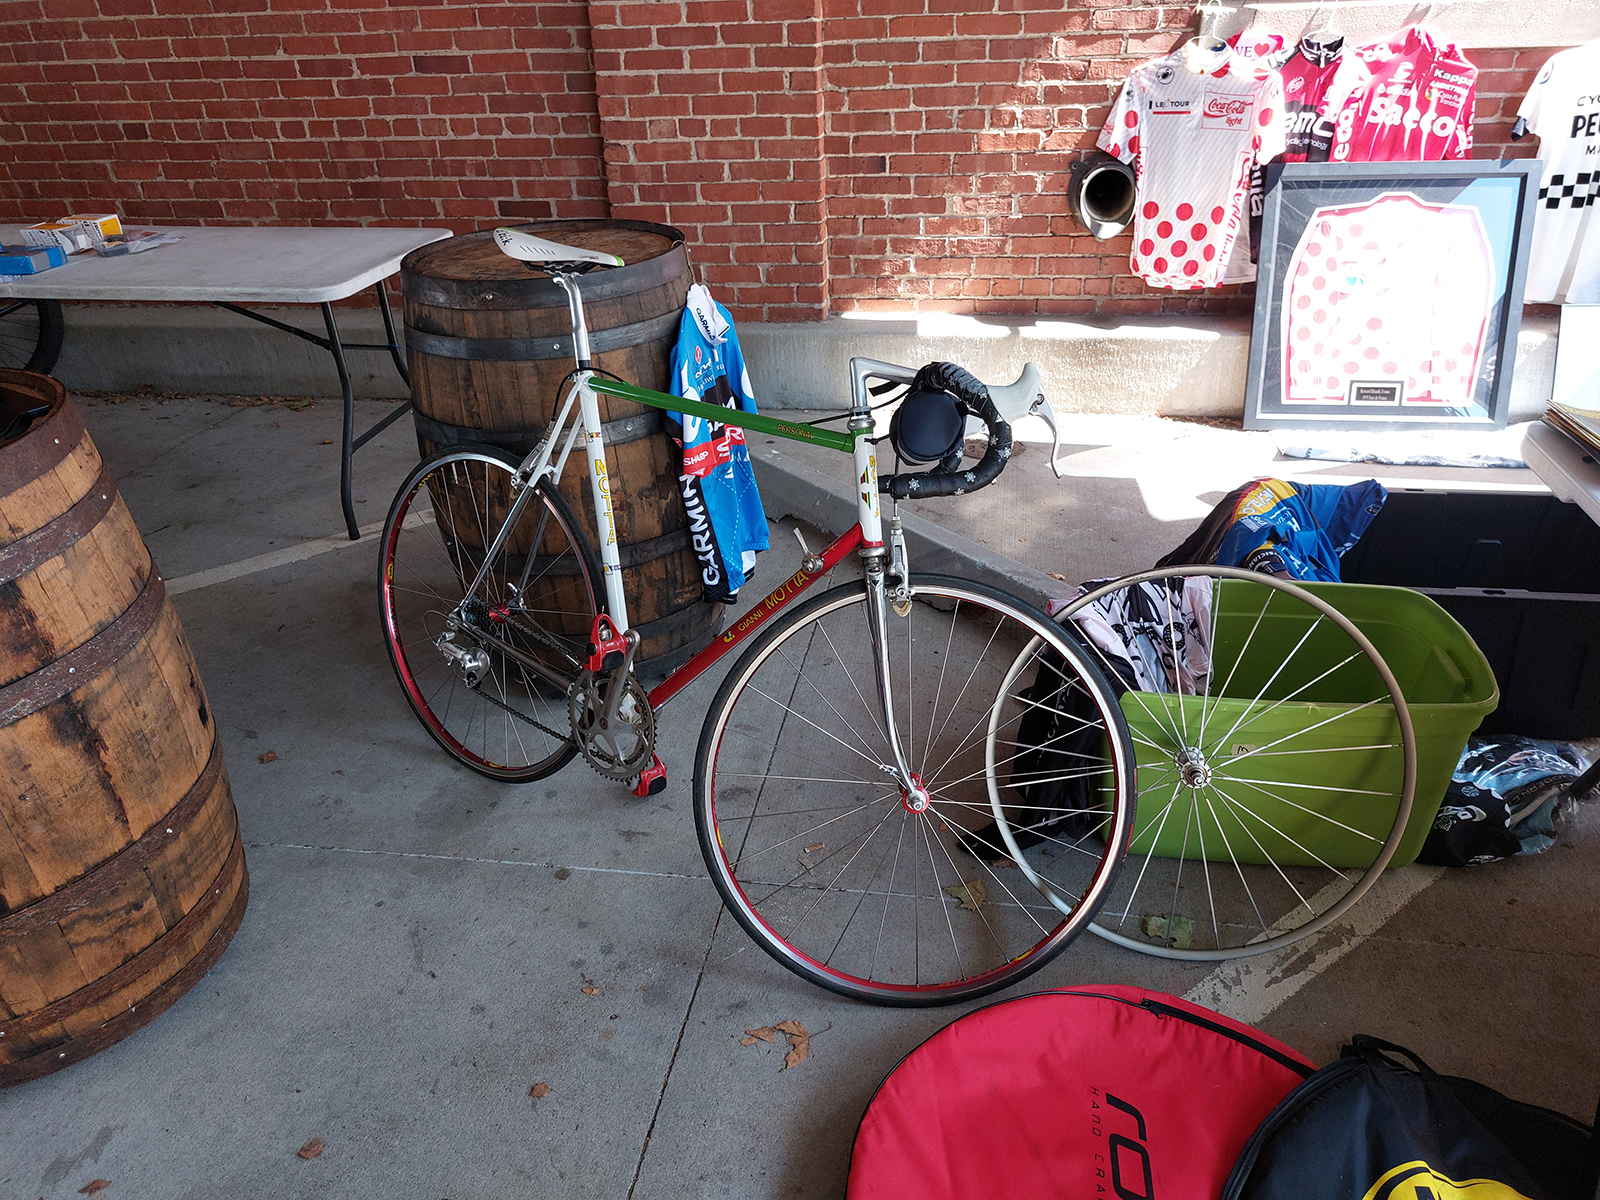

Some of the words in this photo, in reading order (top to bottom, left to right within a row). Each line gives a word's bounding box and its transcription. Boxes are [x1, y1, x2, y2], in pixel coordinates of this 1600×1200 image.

[1170, 100, 1190, 108] TOUR
[1368, 96, 1456, 138] Saeco
[1577, 94, 1600, 107] CY
[1225, 116, 1243, 127] light
[1570, 112, 1600, 139] PE
[776, 423, 815, 441] PERSONAL
[683, 450, 710, 467] SHARP
[594, 458, 618, 547] MOTTA
[679, 472, 721, 587] GARMIN
[737, 609, 764, 632] GIANNI
[764, 570, 810, 611] MOTTA
[1090, 1086, 1103, 1138] HAND
[1094, 1153, 1107, 1200] CRA
